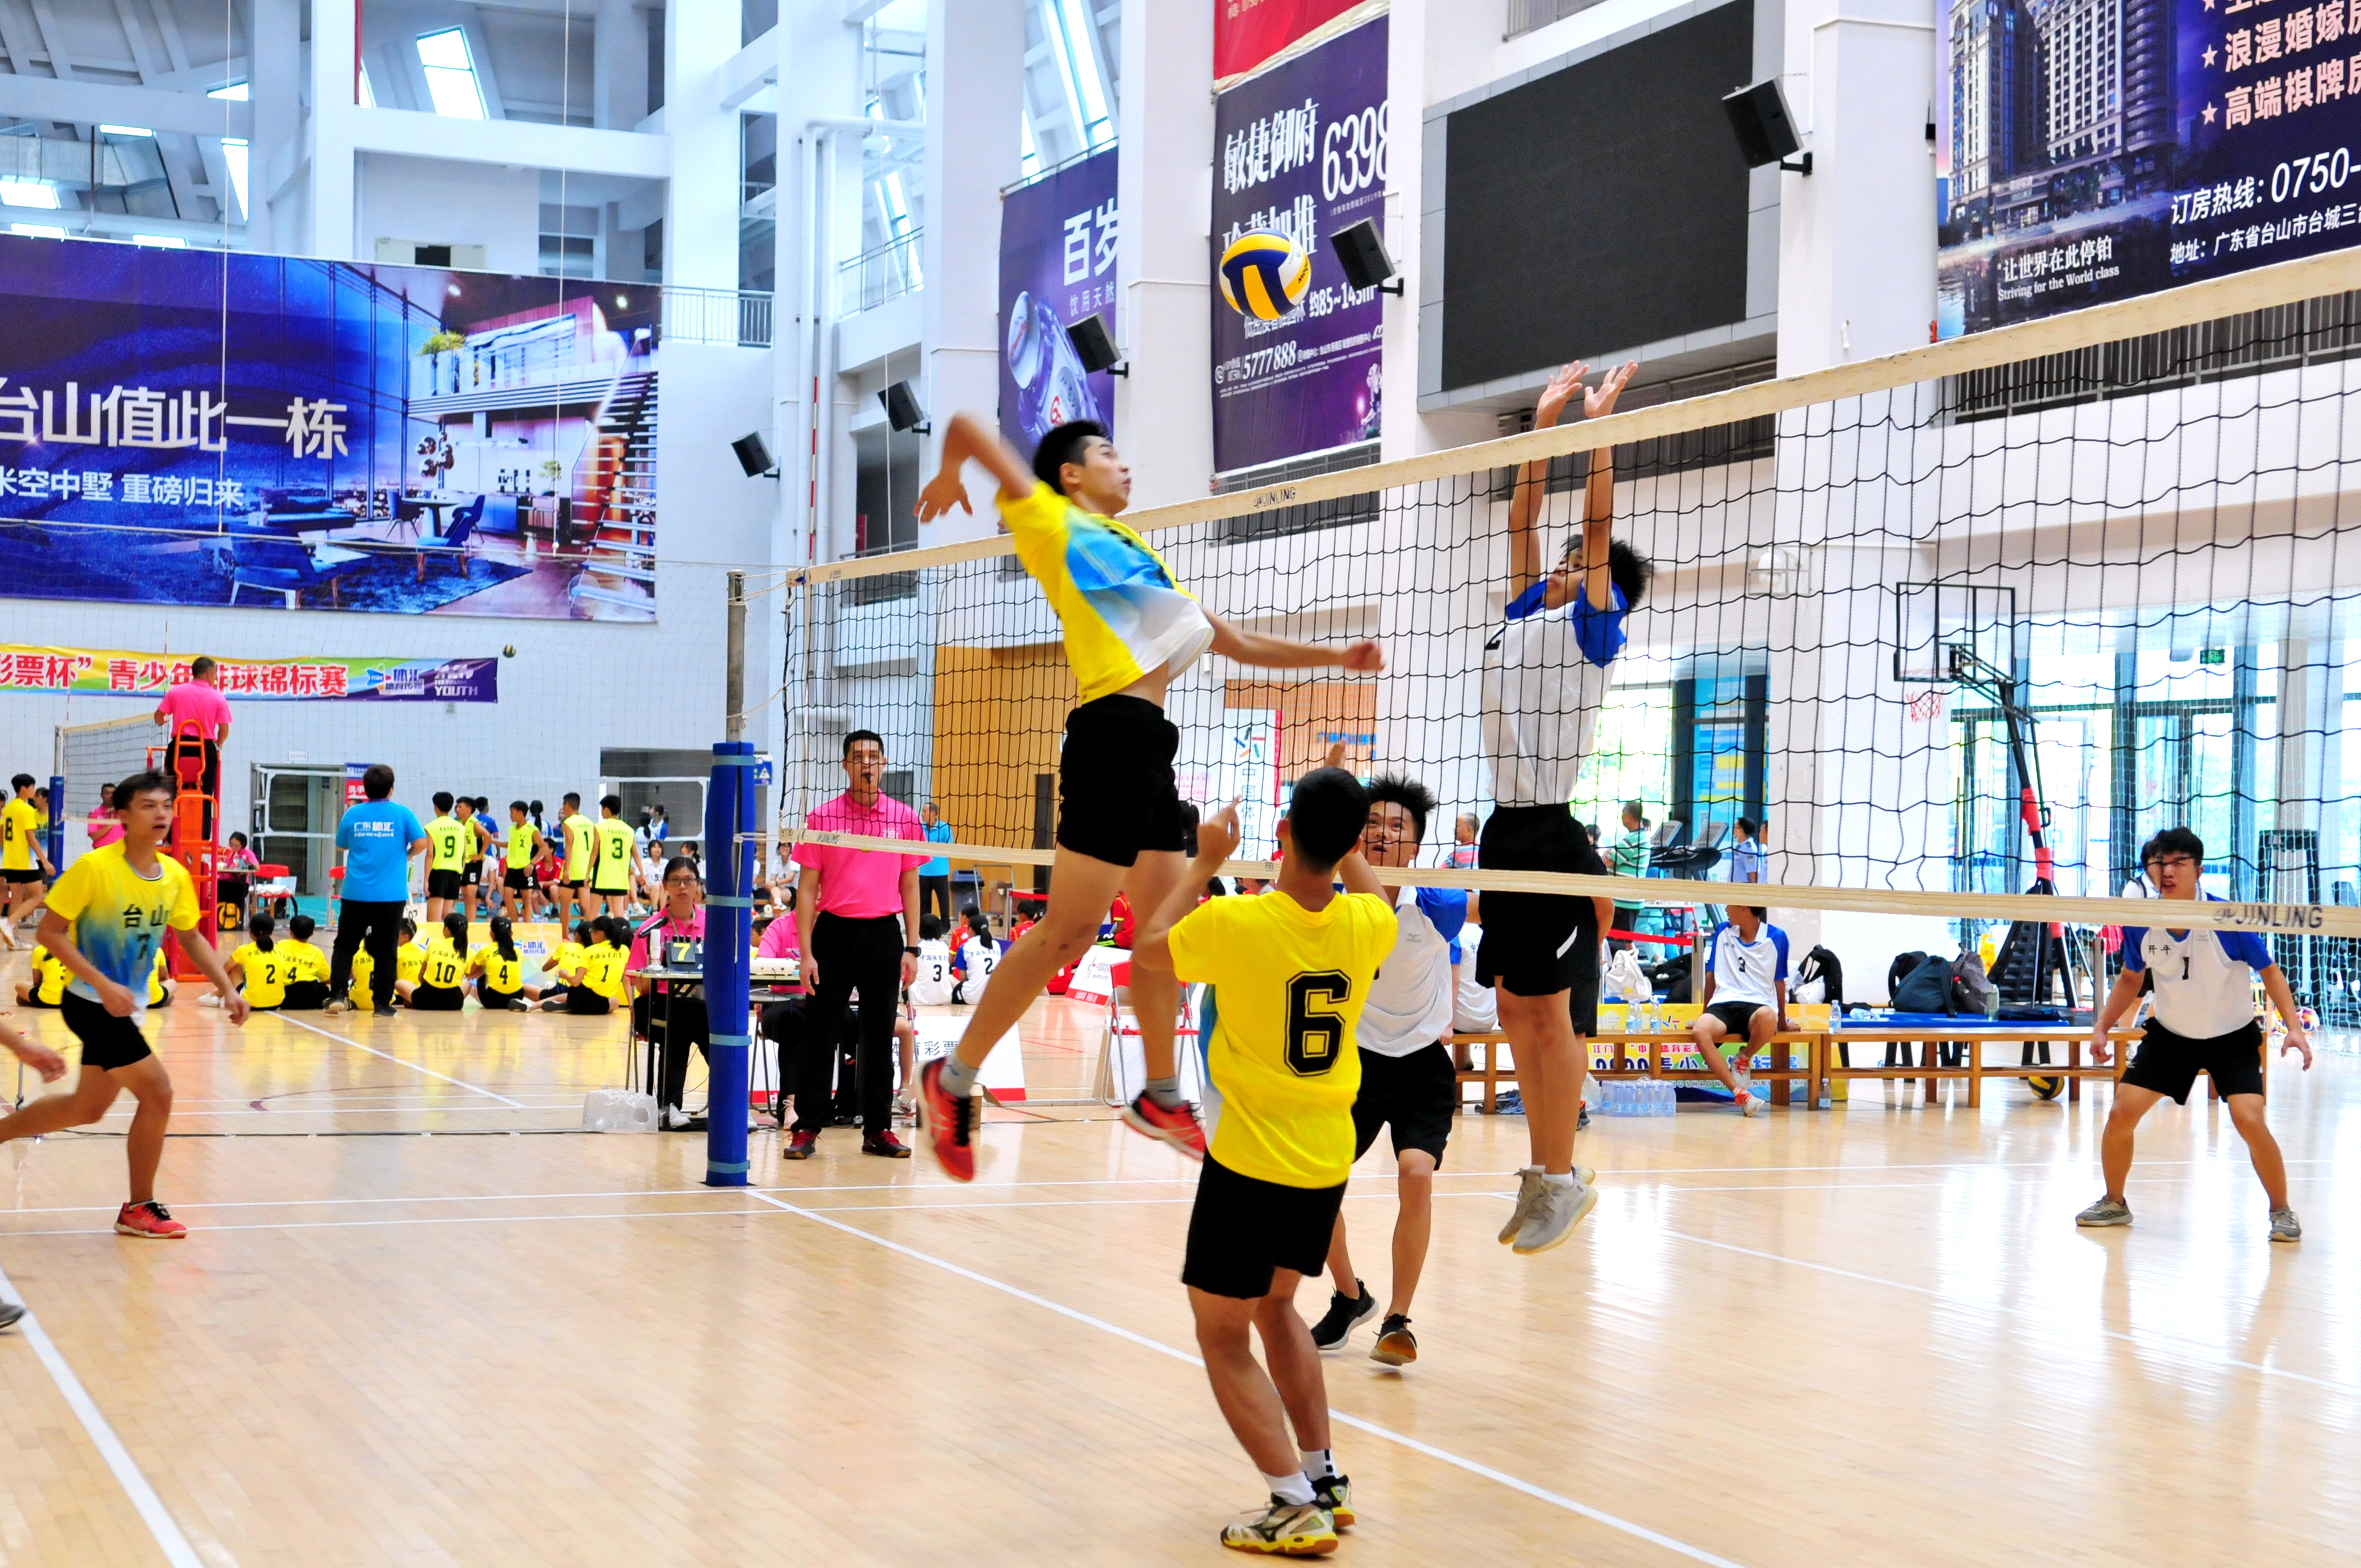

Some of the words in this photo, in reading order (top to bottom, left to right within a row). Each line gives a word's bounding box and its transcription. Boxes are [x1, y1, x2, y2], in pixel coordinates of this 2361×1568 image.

[1224, 98, 1319, 194] 敏捷御府
[2214, 203, 2361, 256] 广东省台山市台城三
[1998, 285, 2033, 302] Striving
[2034, 281, 2047, 294] for
[2049, 277, 2064, 290] the
[2066, 269, 2094, 286] World
[2095, 265, 2120, 280] class
[1242, 340, 1297, 380] 5777888
[0, 376, 348, 460] 台山值此一栋
[121, 473, 244, 508] 重磅归来
[434, 685, 478, 697] YOUTH
[5, 817, 13, 841] 8
[444, 836, 455, 858] 9
[583, 831, 590, 851] 1
[612, 838, 624, 859] 3
[527, 876, 534, 887] 2
[122, 903, 169, 929] 台山
[2236, 905, 2323, 929] JINLING
[137, 933, 151, 960] 7
[672, 942, 691, 962] 7
[266, 964, 275, 984] 2
[287, 967, 297, 982] 4
[435, 962, 456, 984] 10
[499, 965, 508, 985] 4
[601, 964, 609, 982] 1
[933, 964, 942, 982] 3
[984, 957, 994, 974] 2
[2182, 956, 2190, 980] 1
[1284, 969, 1352, 1077] 6
